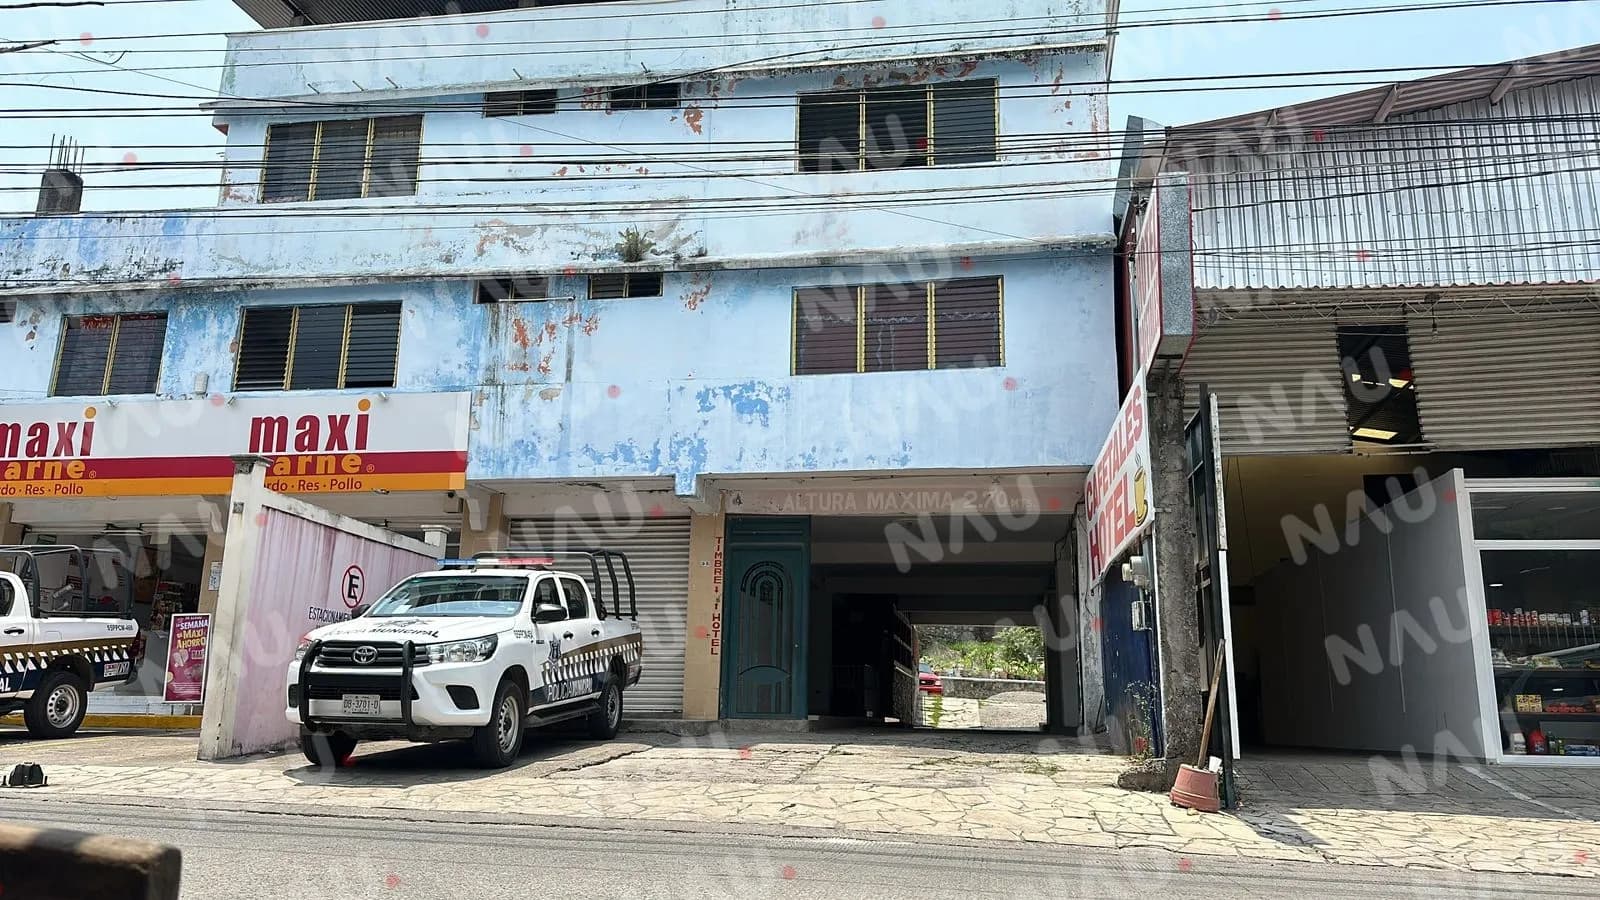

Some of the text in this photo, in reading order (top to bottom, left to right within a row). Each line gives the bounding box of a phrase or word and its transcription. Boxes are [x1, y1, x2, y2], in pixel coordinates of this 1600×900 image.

[249, 399, 371, 453] maxi
[1086, 385, 1143, 522] CAFETALES
[0, 483, 84, 496] do Res Pollo
[298, 480, 320, 491] Res
[330, 478, 362, 490] Pollo
[784, 491, 857, 511] ALTURA
[867, 491, 953, 510] MAXIMA
[1089, 471, 1136, 581] HOTEL
[711, 536, 723, 656] TIMBRE HOTEL
